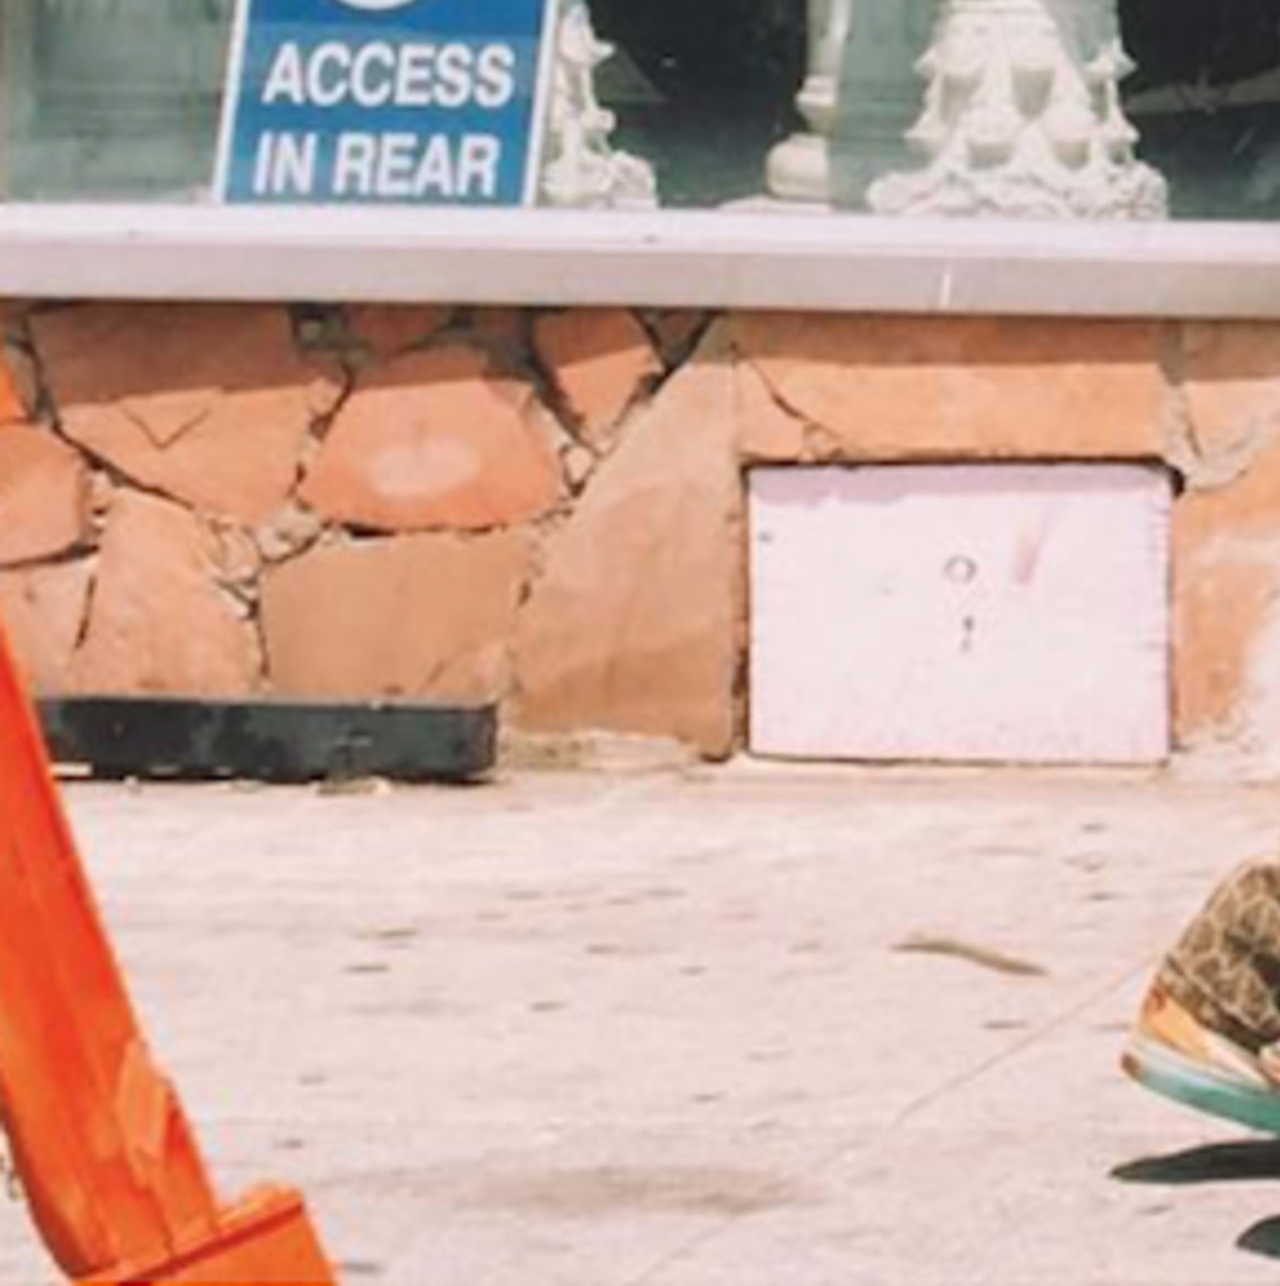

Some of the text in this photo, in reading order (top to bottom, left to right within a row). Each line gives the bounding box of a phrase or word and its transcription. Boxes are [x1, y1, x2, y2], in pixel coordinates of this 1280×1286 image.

[261, 40, 516, 108] ACCESS
[252, 131, 502, 198] IN REAR
